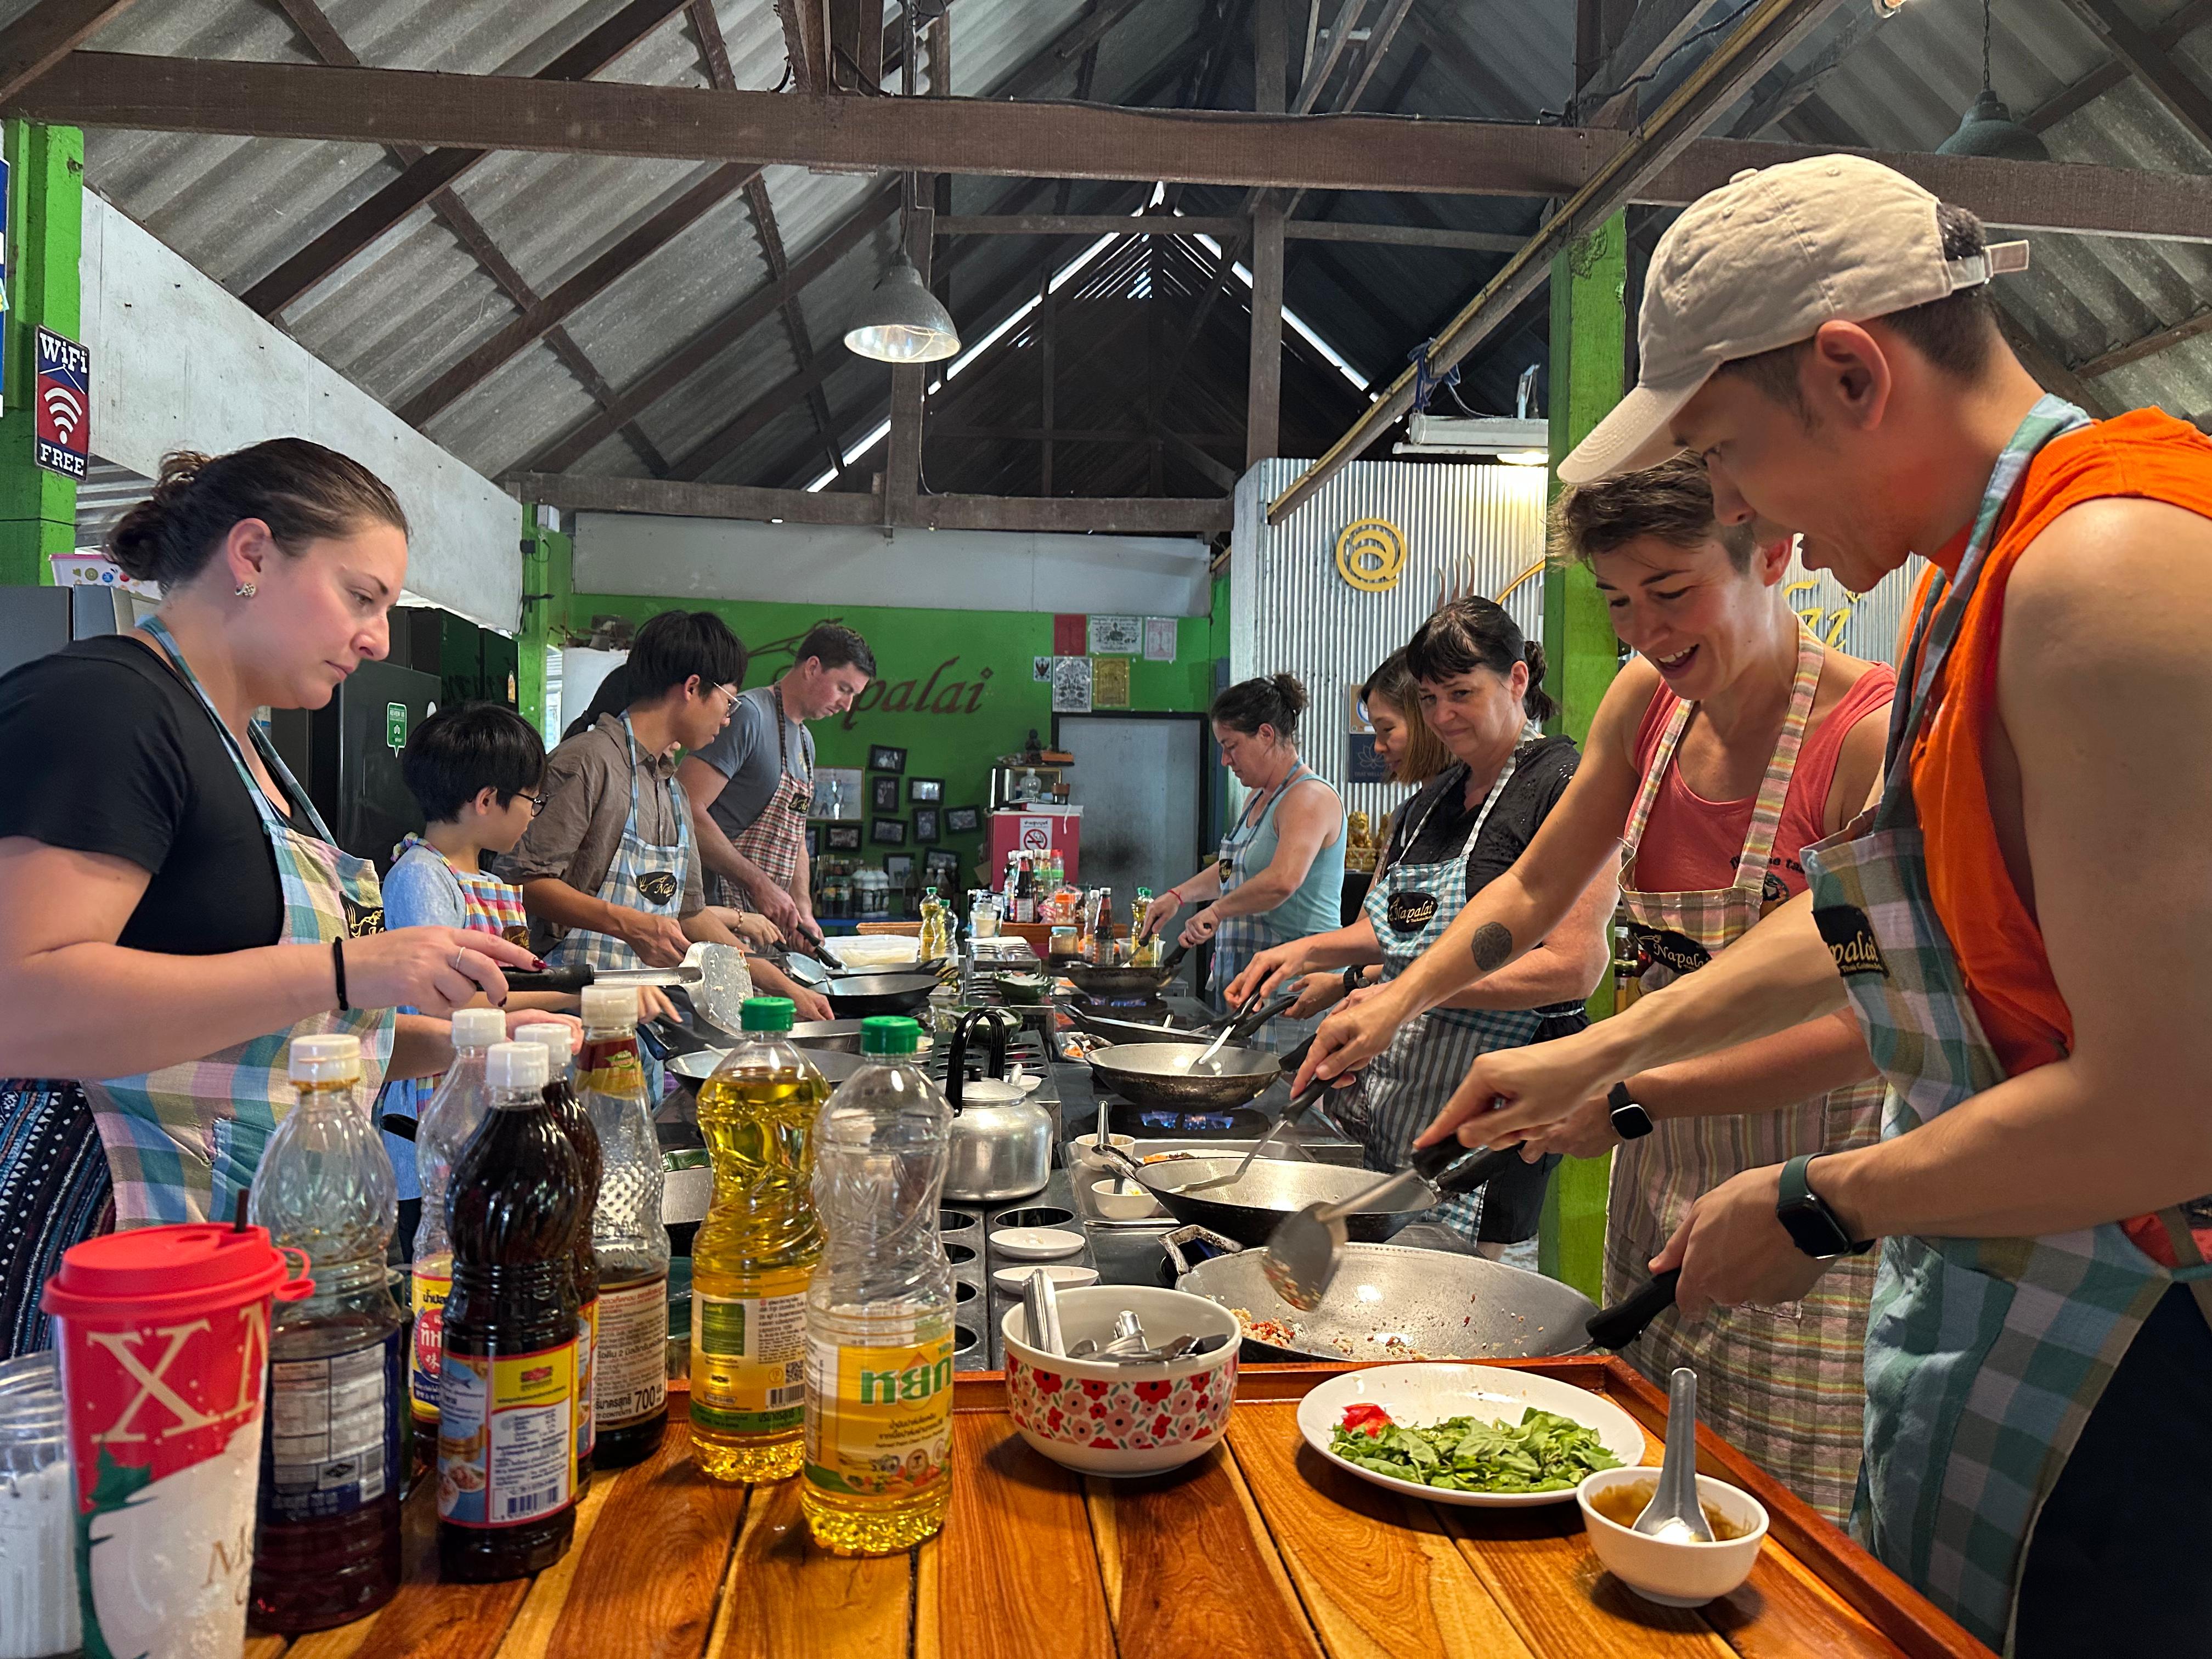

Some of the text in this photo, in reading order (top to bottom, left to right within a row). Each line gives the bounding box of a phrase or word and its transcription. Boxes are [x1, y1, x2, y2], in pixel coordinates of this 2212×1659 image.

[40, 332, 87, 374] WiFi
[40, 443, 84, 477] FREE
[775, 655, 994, 731] palai
[1394, 900, 1434, 923] Napalai
[1830, 930, 1878, 964] palai
[635, 1386, 655, 1413] 700
